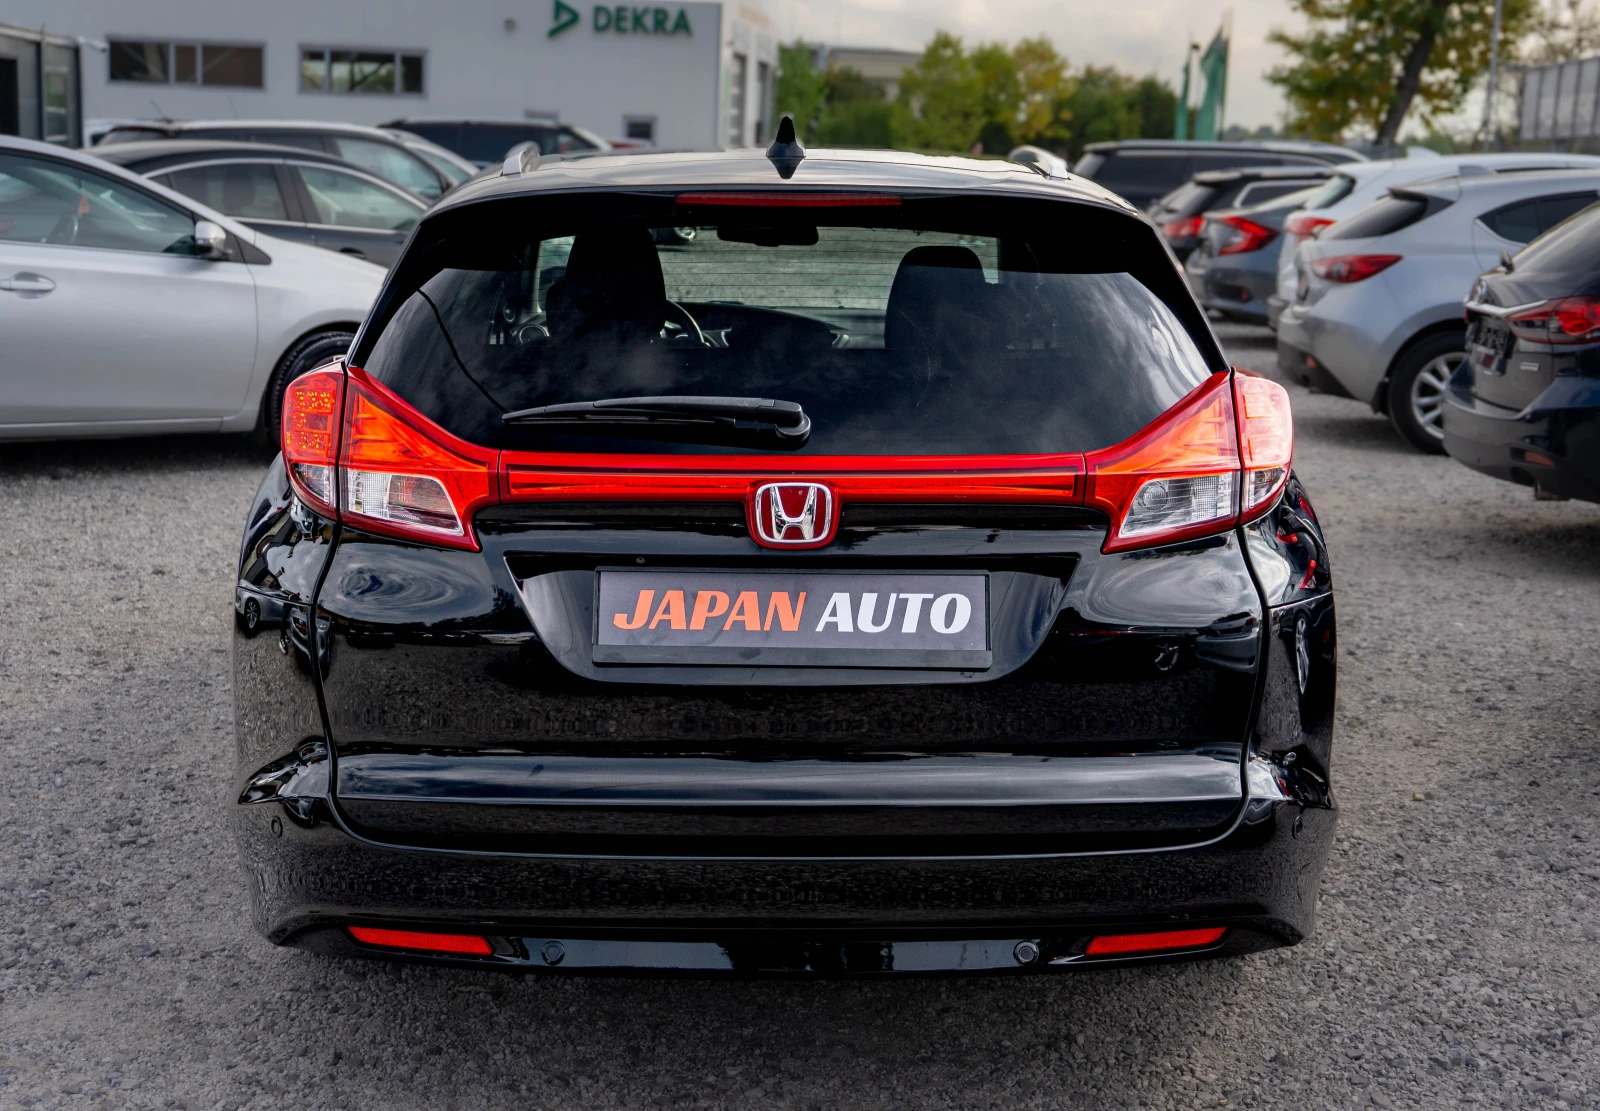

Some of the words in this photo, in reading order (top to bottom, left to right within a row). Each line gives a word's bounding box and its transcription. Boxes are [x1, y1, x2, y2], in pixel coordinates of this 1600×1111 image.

[592, 5, 693, 38] DEKRA
[612, 589, 807, 632] JAPAN
[814, 592, 972, 635] AUTO
